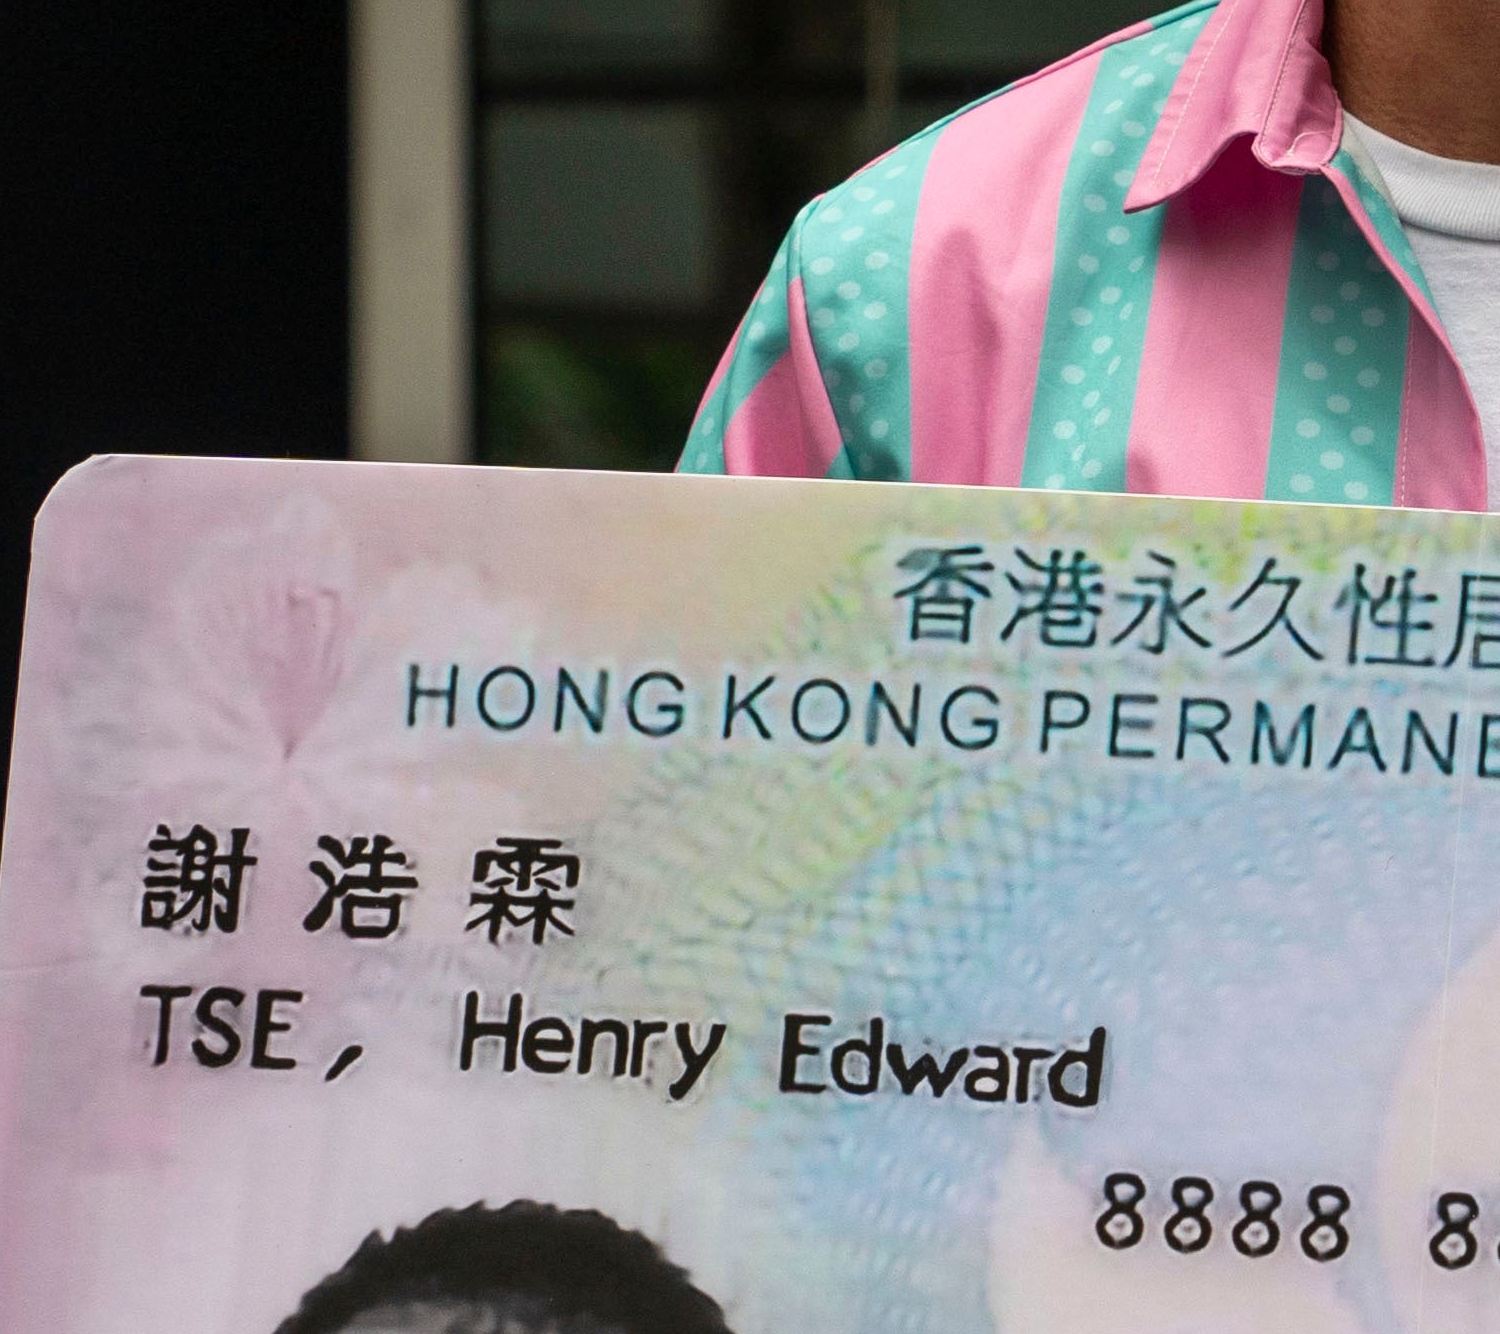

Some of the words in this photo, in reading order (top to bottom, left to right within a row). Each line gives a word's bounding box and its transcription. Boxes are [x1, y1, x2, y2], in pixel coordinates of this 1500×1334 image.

[405, 661, 688, 738] HONG
[721, 672, 1001, 753] KONG
[139, 822, 582, 946] 謝浩霖
[139, 984, 366, 1083] TSE,
[459, 991, 727, 1101] Henry
[777, 1013, 1107, 1108] Edward
[1094, 1170, 1352, 1263] 8888
